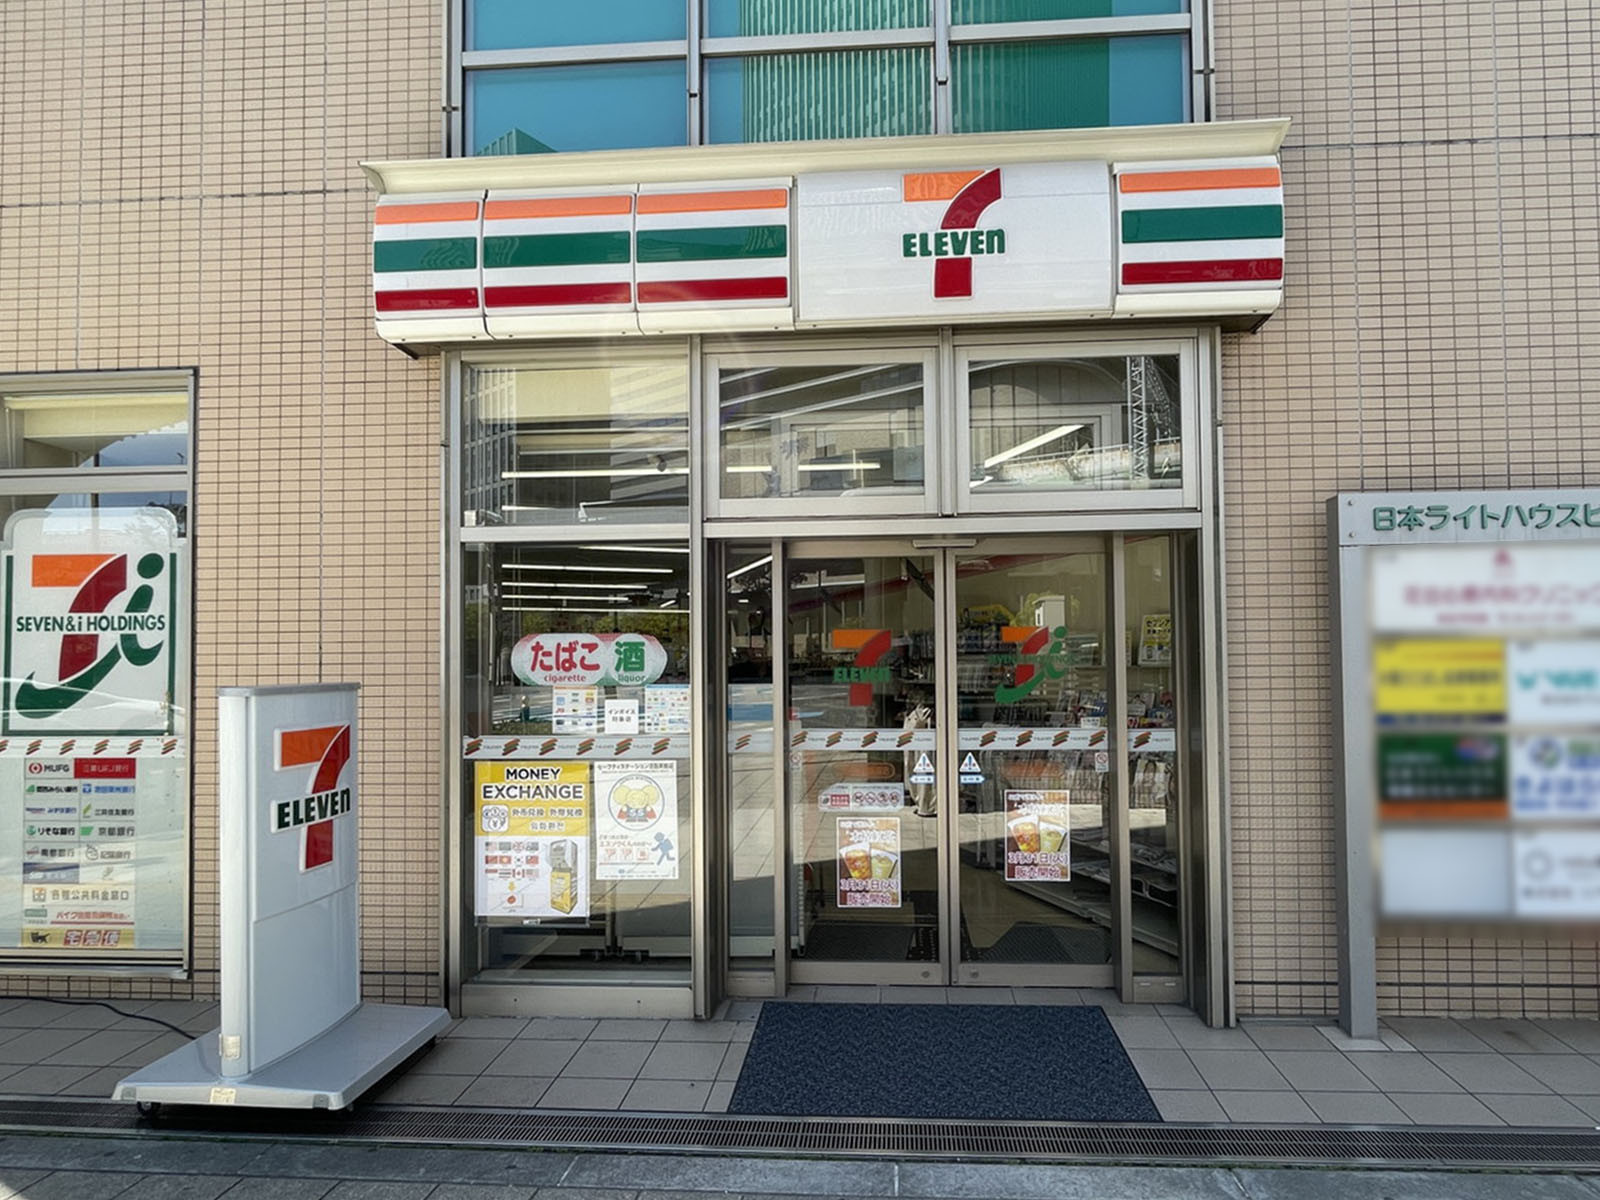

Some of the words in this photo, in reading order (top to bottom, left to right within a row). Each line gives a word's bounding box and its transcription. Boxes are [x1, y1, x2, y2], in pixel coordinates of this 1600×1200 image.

[16, 615, 83, 632] SEVEN&i
[87, 614, 165, 631] HOLDINGS
[530, 640, 601, 673] たばこ
[614, 641, 646, 672] 酒
[543, 674, 586, 683] cigarette
[618, 674, 645, 683] liquor
[44, 764, 70, 773] MUFG
[506, 768, 560, 780] MONEY
[483, 785, 583, 799] EXCHANGE
